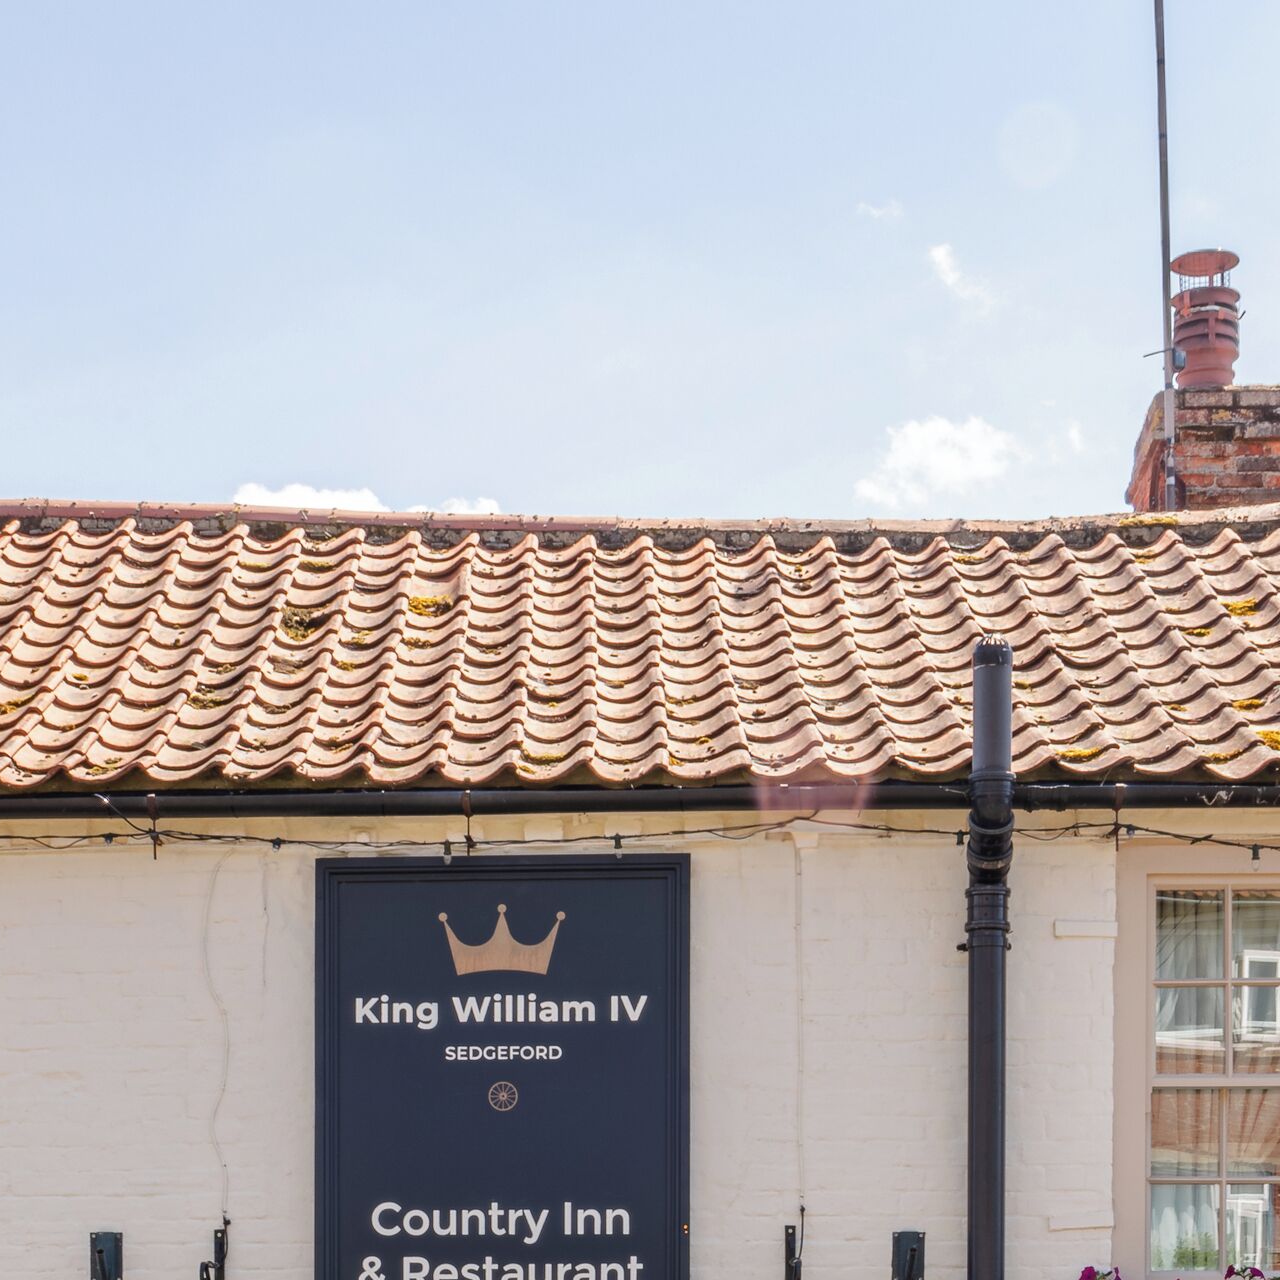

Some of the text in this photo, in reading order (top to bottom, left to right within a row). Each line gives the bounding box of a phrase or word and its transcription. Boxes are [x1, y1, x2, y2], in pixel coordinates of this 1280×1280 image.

[356, 993, 647, 1029] King William IV
[446, 1046, 562, 1060] SEDGEFORD
[372, 1202, 629, 1244] Country Inn
